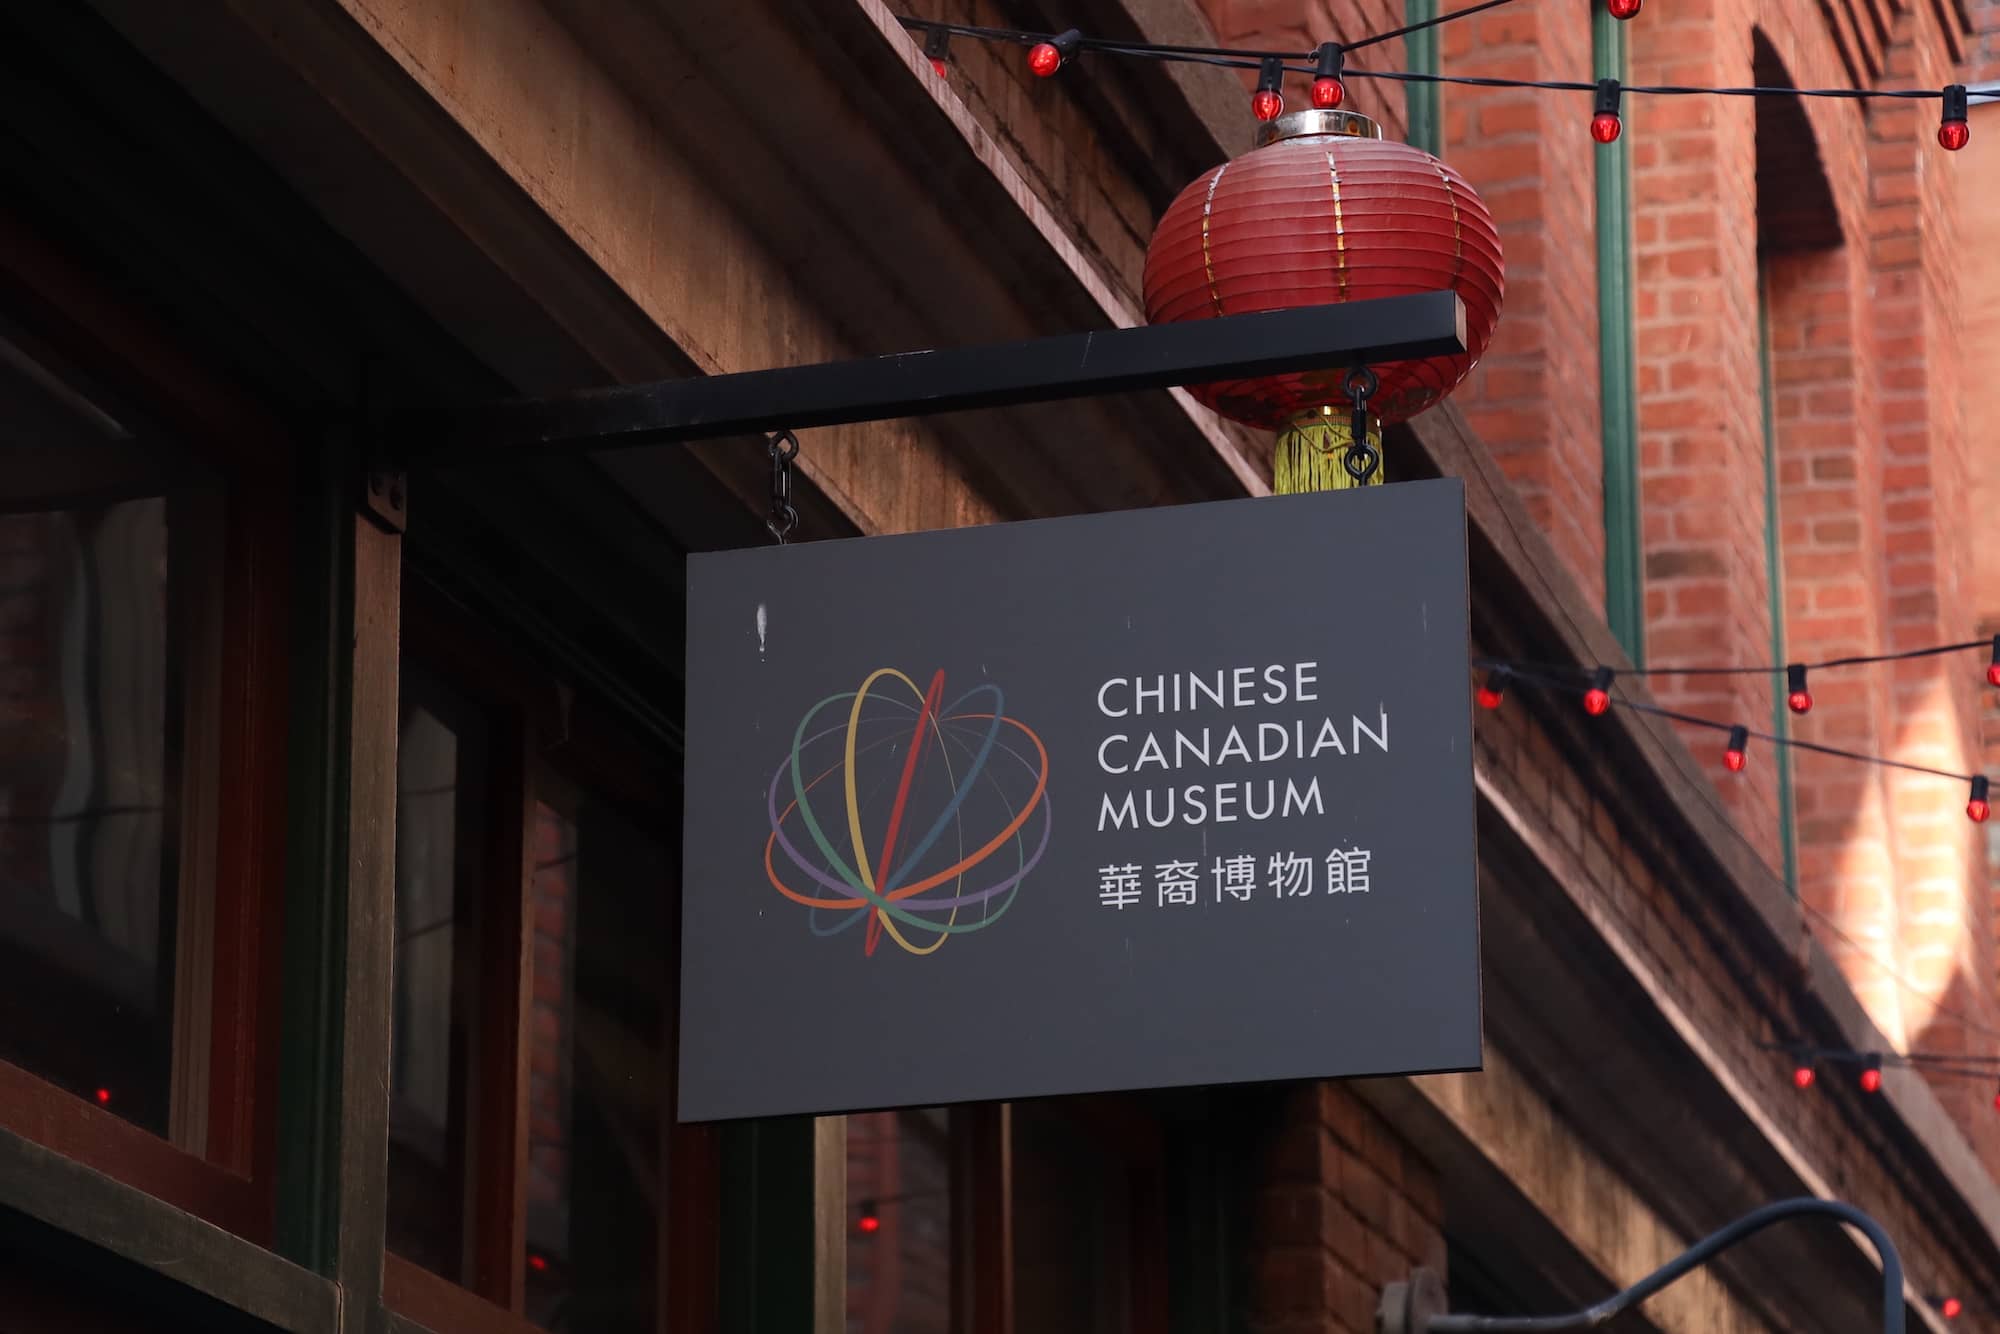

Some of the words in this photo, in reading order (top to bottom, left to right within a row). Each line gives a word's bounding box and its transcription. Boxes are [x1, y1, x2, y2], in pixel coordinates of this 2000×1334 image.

[1097, 661, 1318, 718] CHINESE
[1097, 712, 1389, 774] CANADIAN
[1097, 775, 1325, 832] MUSEUM
[1098, 846, 1372, 910] 華裔博物館
